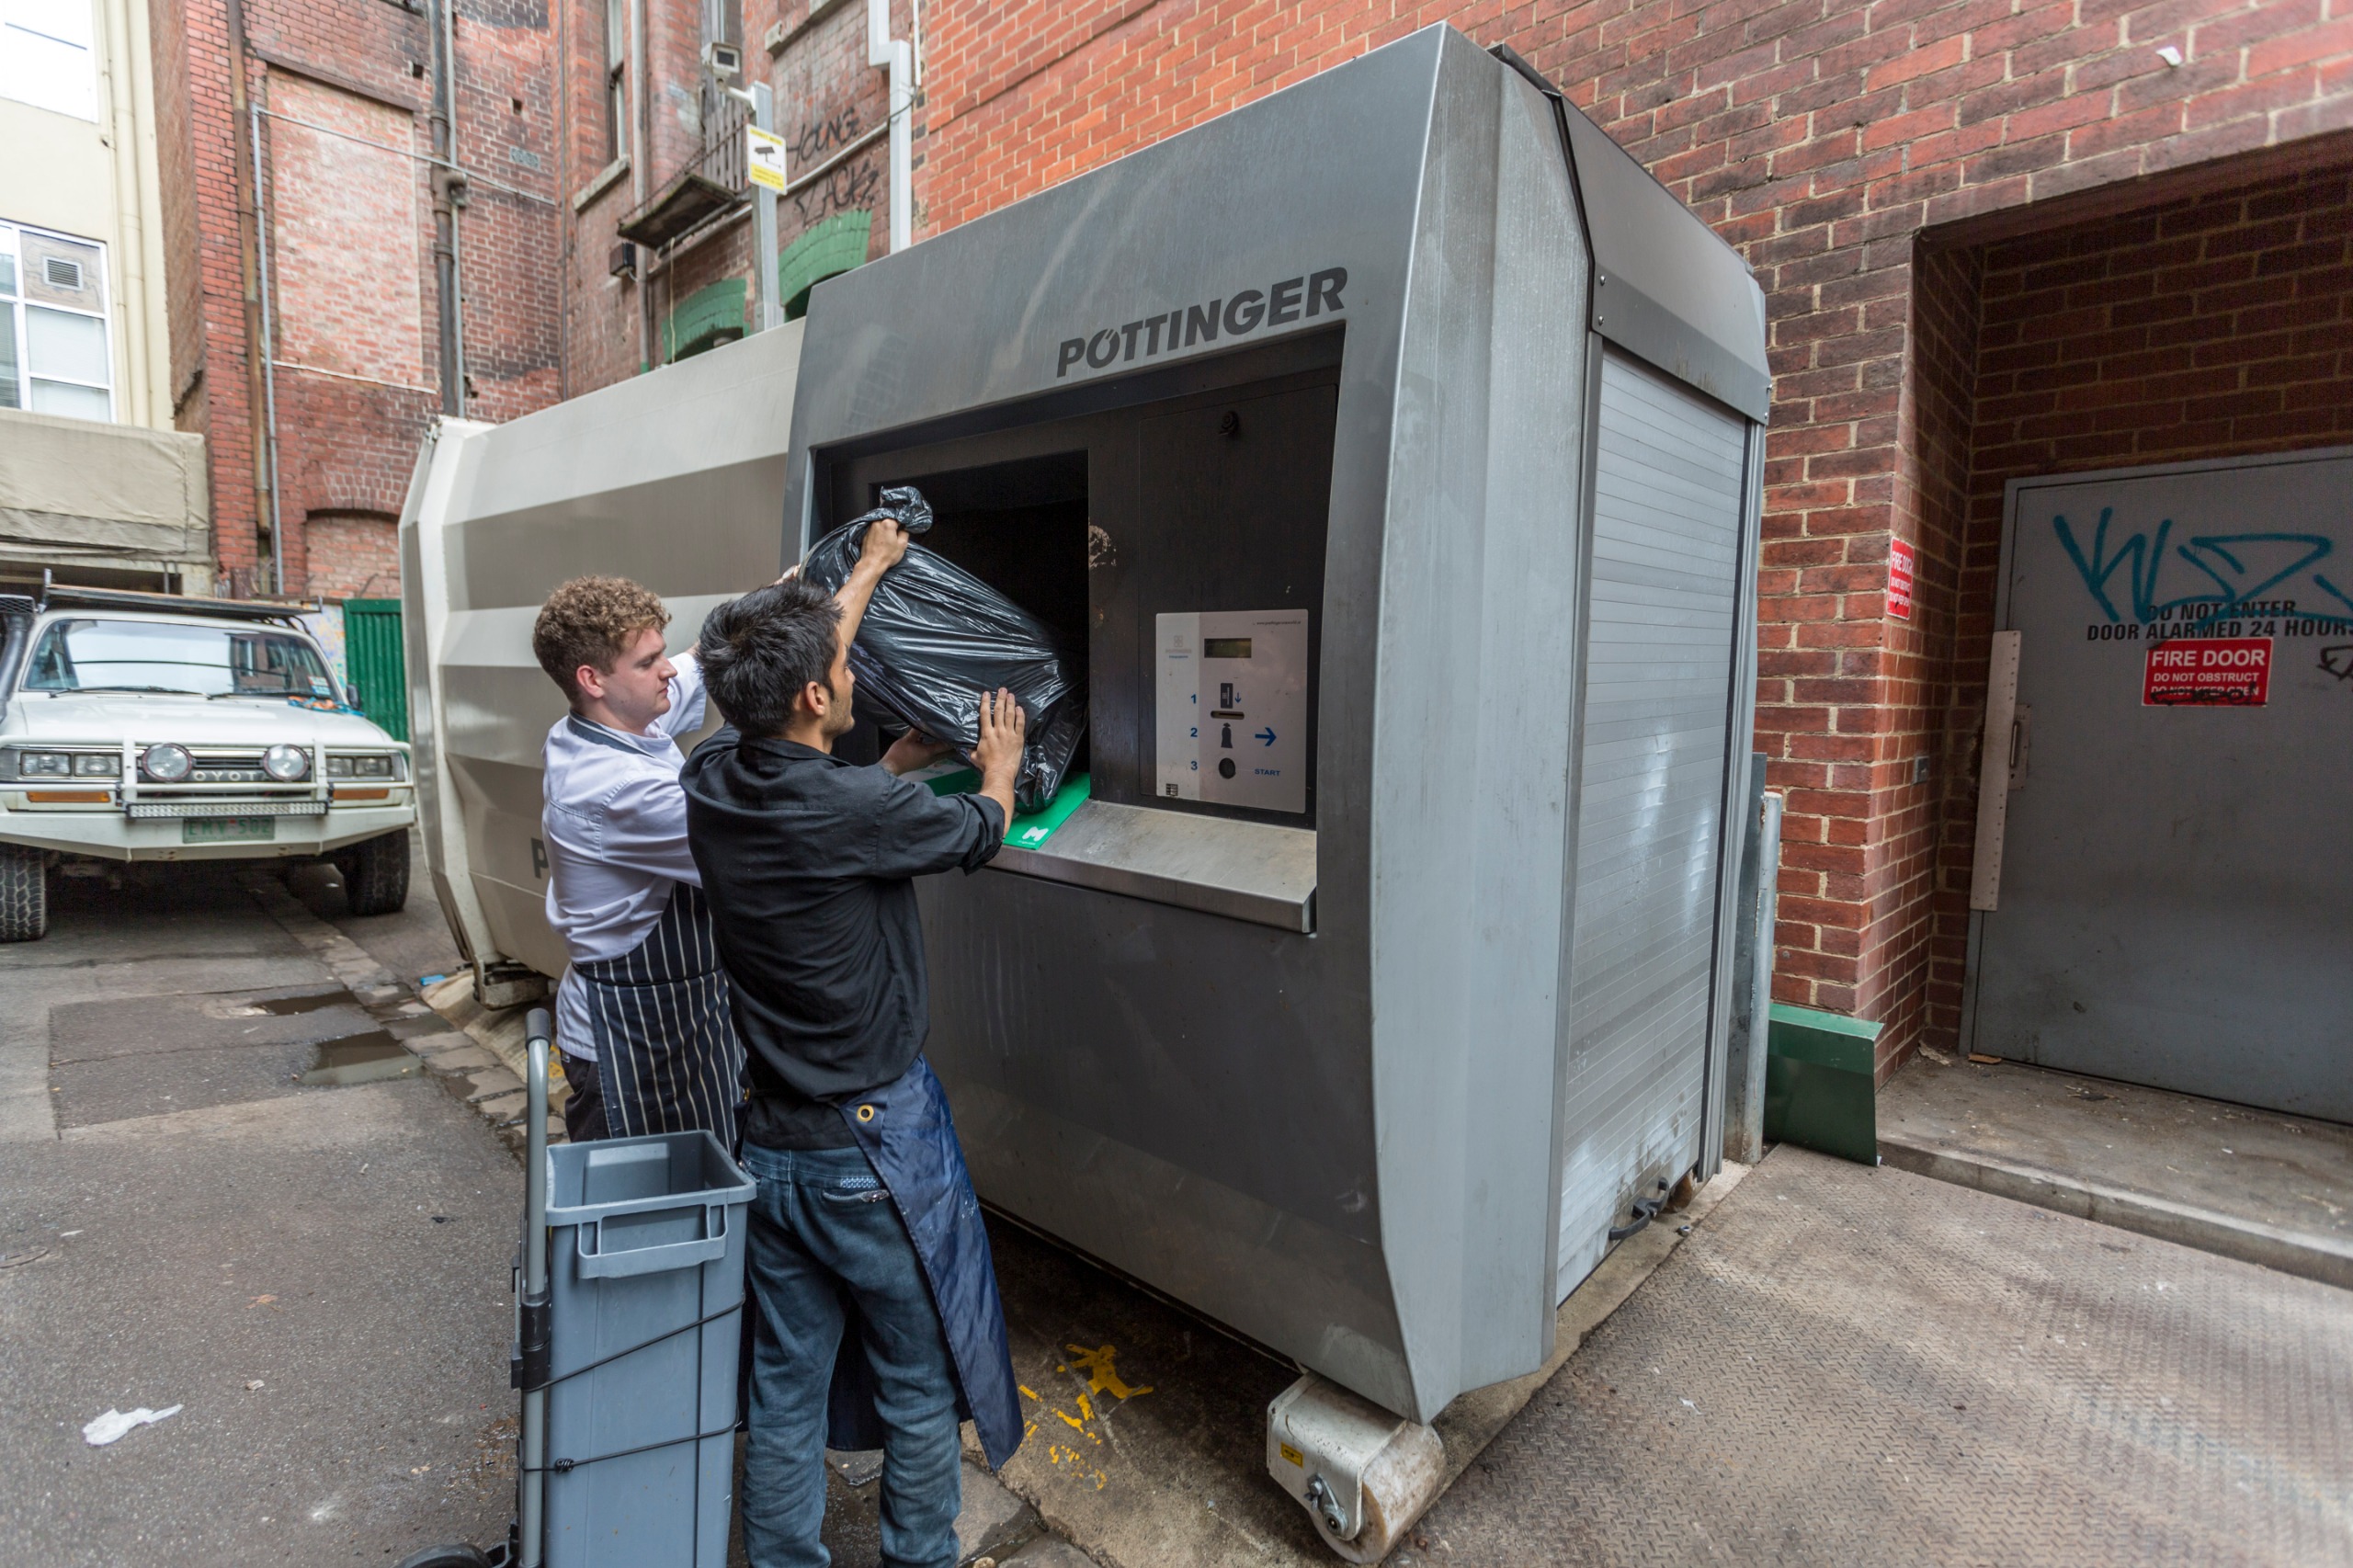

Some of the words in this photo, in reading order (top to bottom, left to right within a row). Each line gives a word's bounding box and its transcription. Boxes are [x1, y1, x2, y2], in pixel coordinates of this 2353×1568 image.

[2180, 603, 2222, 620] NOT
[2229, 600, 2296, 619] ENTER
[2087, 624, 2140, 641] DOOR
[2145, 621, 2242, 640] ALARMED
[2248, 620, 2277, 637] 24
[2151, 651, 2198, 666] FIRE
[2202, 650, 2267, 666] DOOR
[2154, 672, 2170, 682] DO
[2172, 672, 2195, 682] NOT
[2198, 672, 2260, 682] OBSTRUCT
[1190, 693, 1197, 704] 1
[1190, 727, 1198, 738] 2
[1190, 761, 1198, 771] 3
[193, 771, 272, 781] OYOTA
[1254, 768, 1280, 777] START
